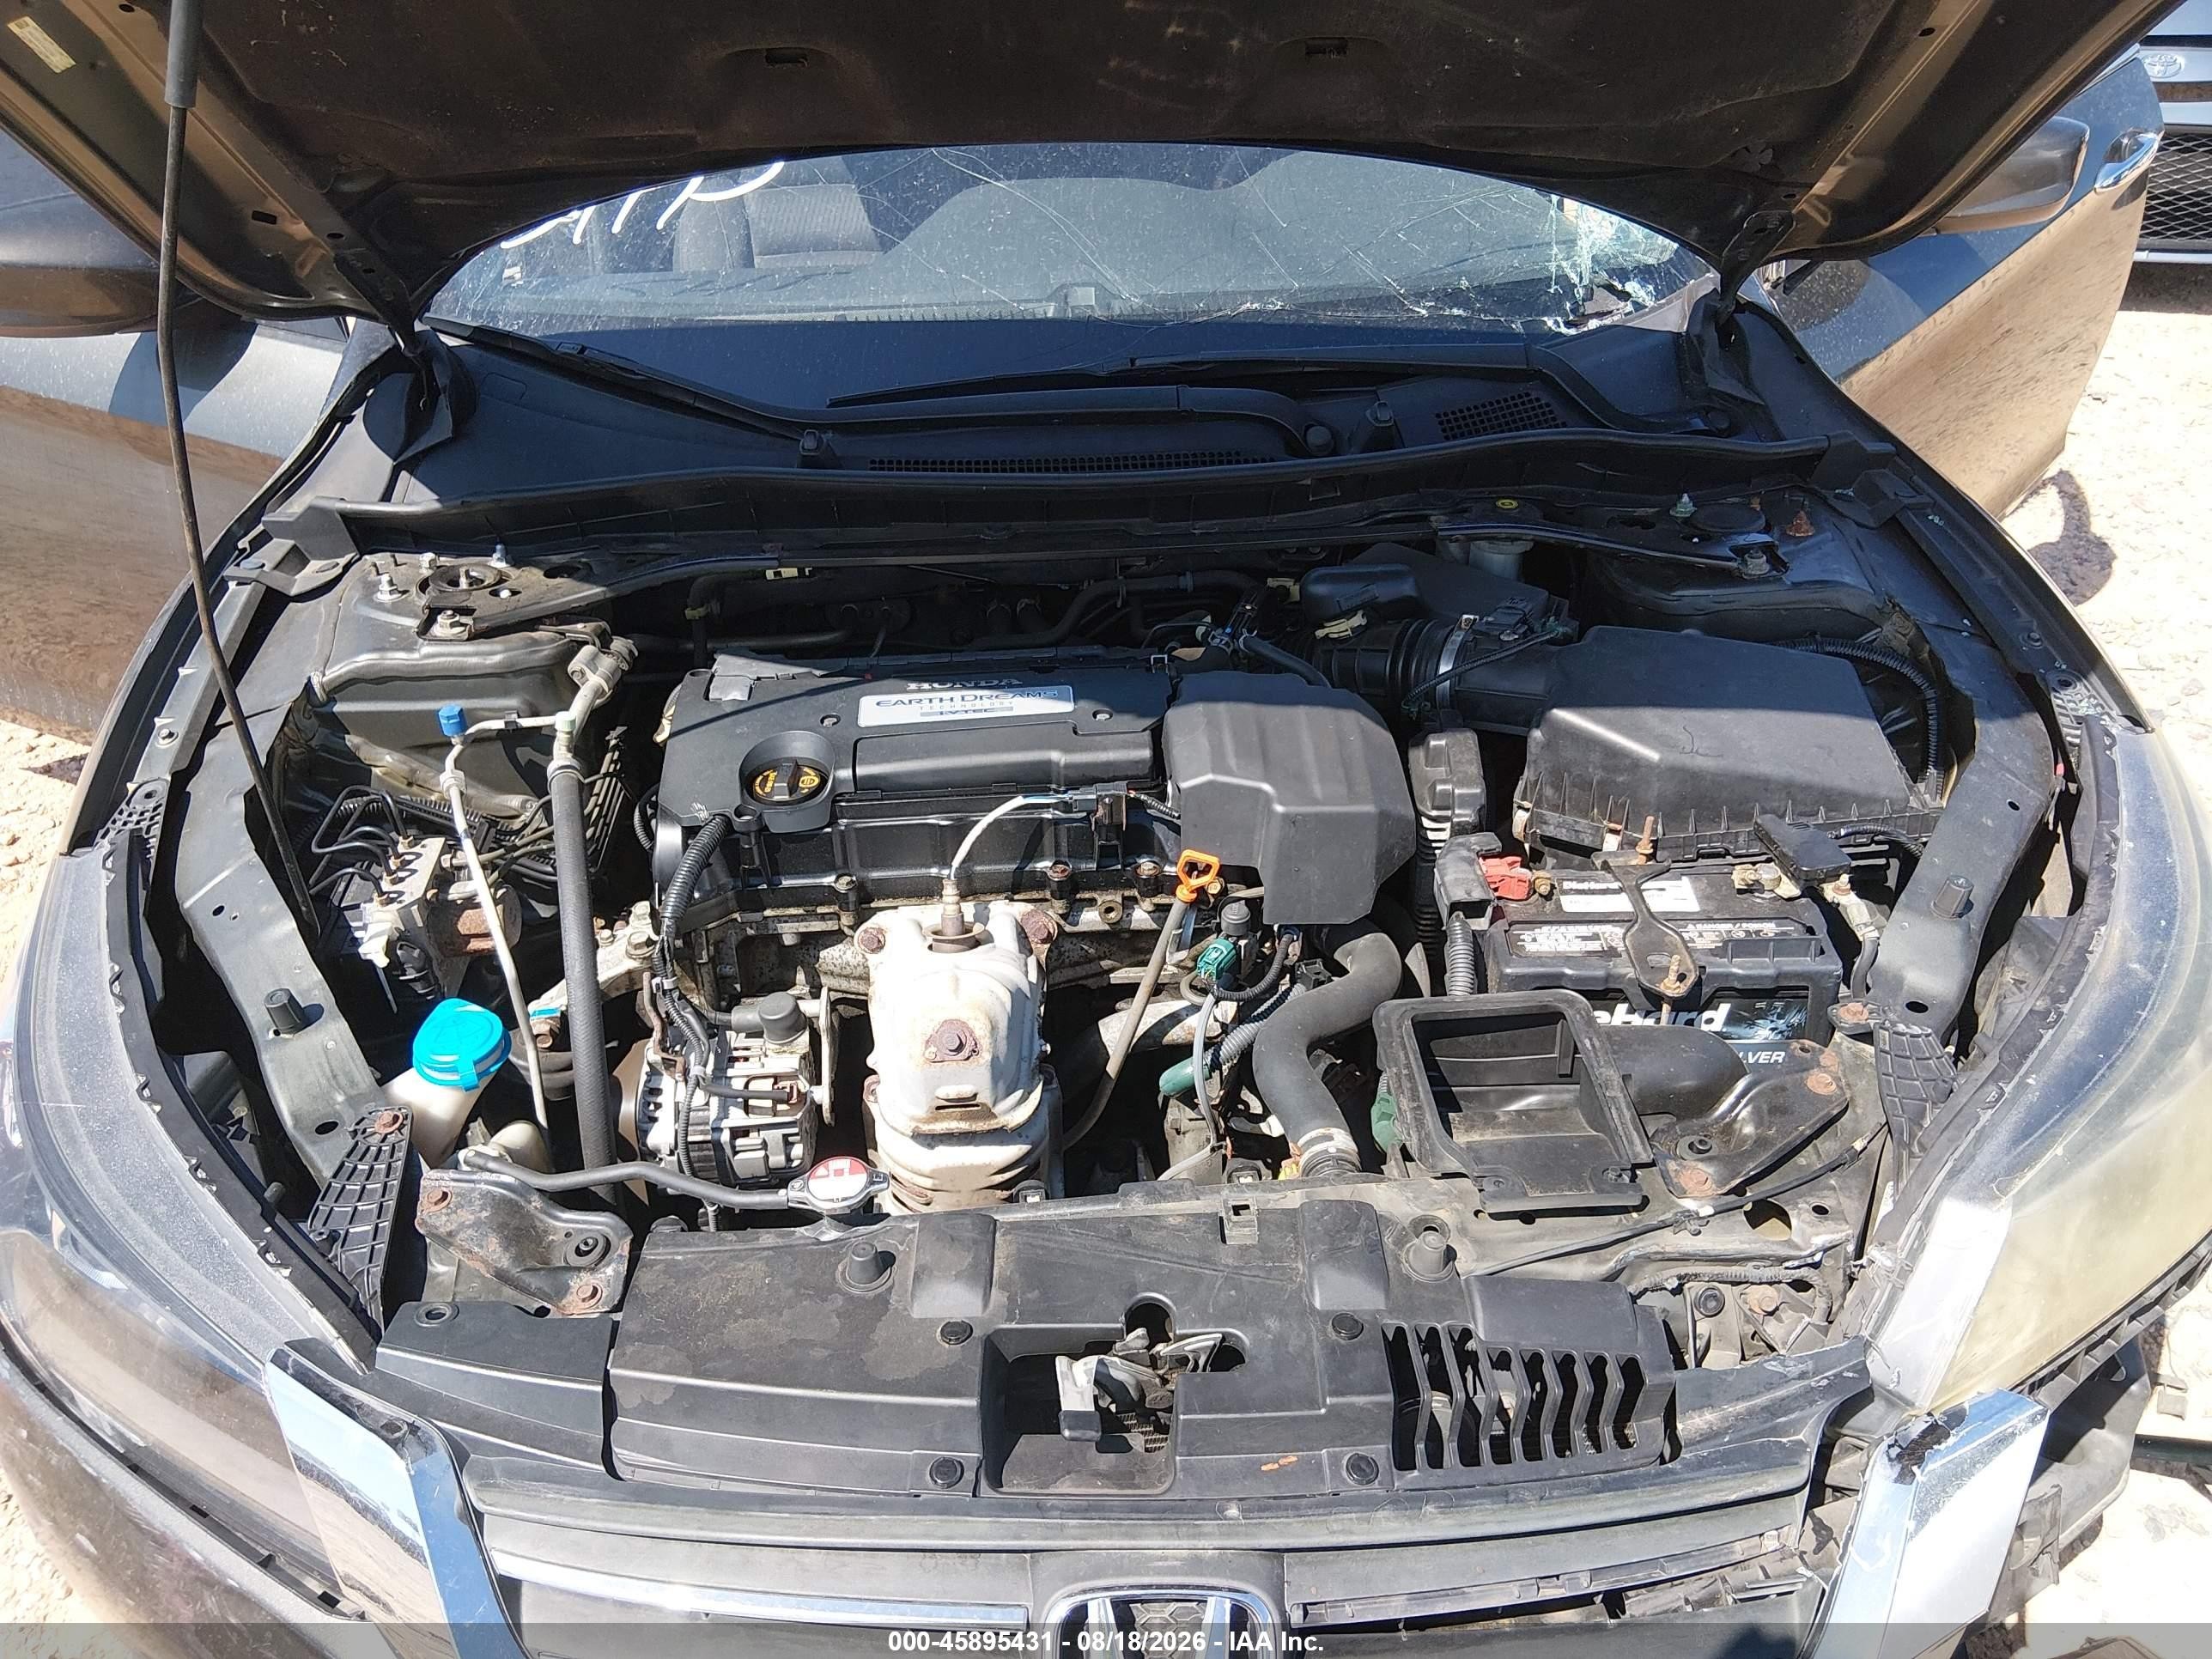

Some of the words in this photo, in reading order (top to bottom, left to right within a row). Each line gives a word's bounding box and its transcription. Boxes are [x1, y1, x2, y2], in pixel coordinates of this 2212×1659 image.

[906, 678, 1024, 690] HONDA
[875, 696, 956, 708] EARTH
[961, 689, 1059, 702] DREAMS
[1594, 1003, 1731, 1031] eHard
[1739, 1051, 1786, 1064] LVER
